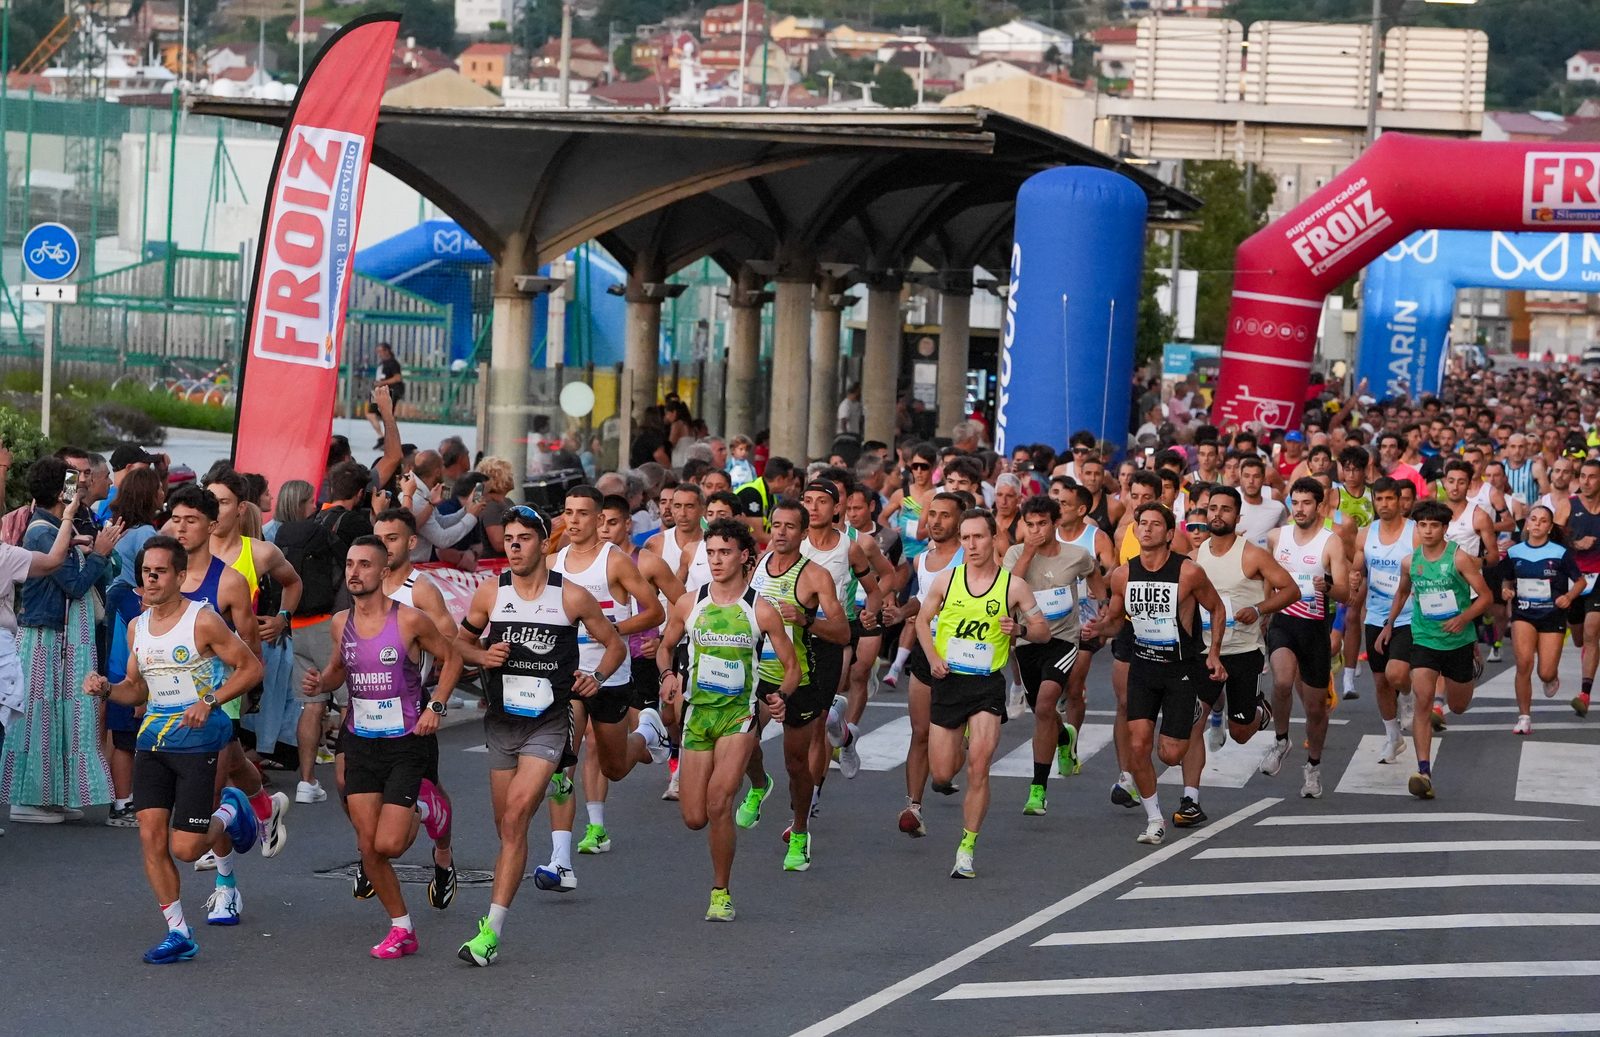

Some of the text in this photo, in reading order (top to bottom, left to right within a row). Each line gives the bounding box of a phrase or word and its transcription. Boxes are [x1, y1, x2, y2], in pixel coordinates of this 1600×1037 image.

[339, 144, 357, 211] servicio
[1531, 157, 1600, 204] FR
[1285, 177, 1367, 239] supermercados
[337, 217, 348, 237] su
[1291, 189, 1386, 268] FROIZ
[261, 133, 342, 360] FROIZ
[1130, 588, 1171, 603] BLUES
[1130, 602, 1170, 613] BROTHERS
[502, 626, 558, 645] delikia
[954, 617, 990, 641] LRC
[692, 629, 752, 645] Natursueño
[975, 643, 987, 651] 274
[507, 660, 559, 671] CABREIROÁ
[724, 661, 739, 670] 960
[173, 675, 179, 684] 3
[351, 671, 392, 685] TAMBRE
[537, 679, 542, 688] 7
[352, 684, 392, 692] ATLETISMO
[377, 700, 393, 710] 746
